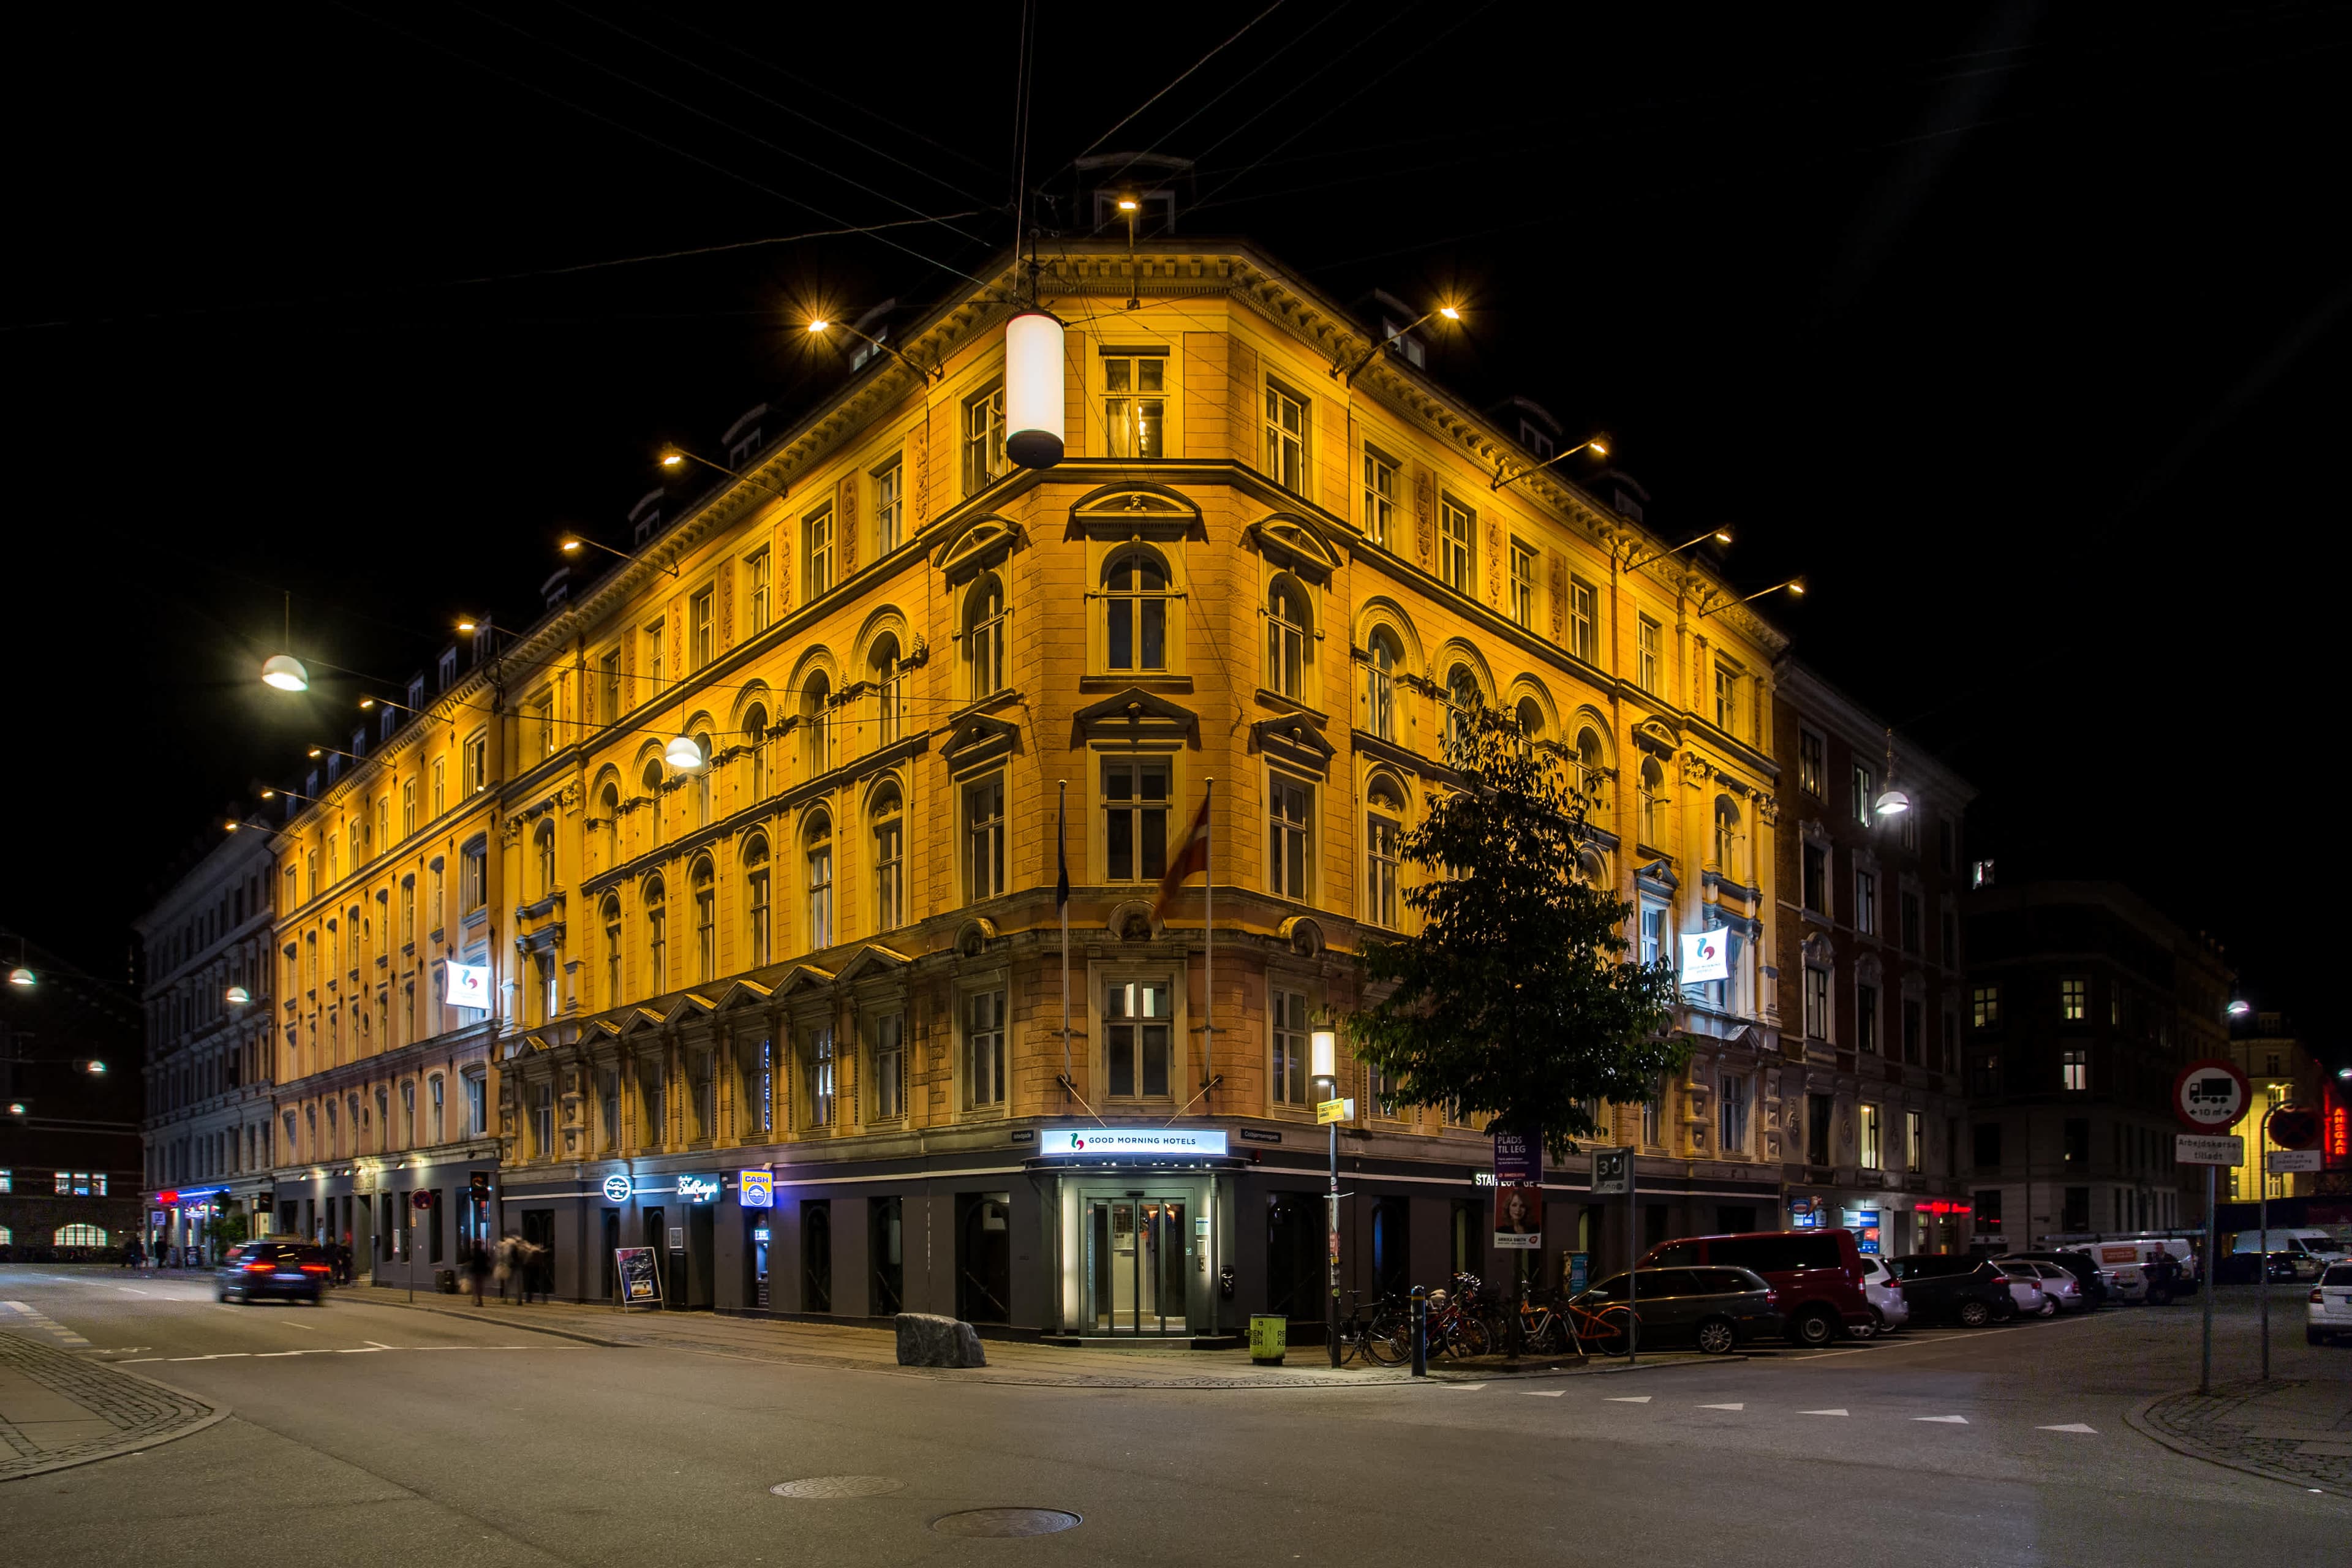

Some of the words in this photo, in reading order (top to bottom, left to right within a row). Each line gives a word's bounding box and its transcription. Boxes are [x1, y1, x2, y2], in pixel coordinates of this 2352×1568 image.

[2334, 1107, 2346, 1155] ANSGAR
[1498, 1136, 1523, 1145] PLADS
[1498, 1145, 1509, 1154] TIL
[1510, 1145, 1526, 1154] LEG
[1599, 1157, 1623, 1175] 30
